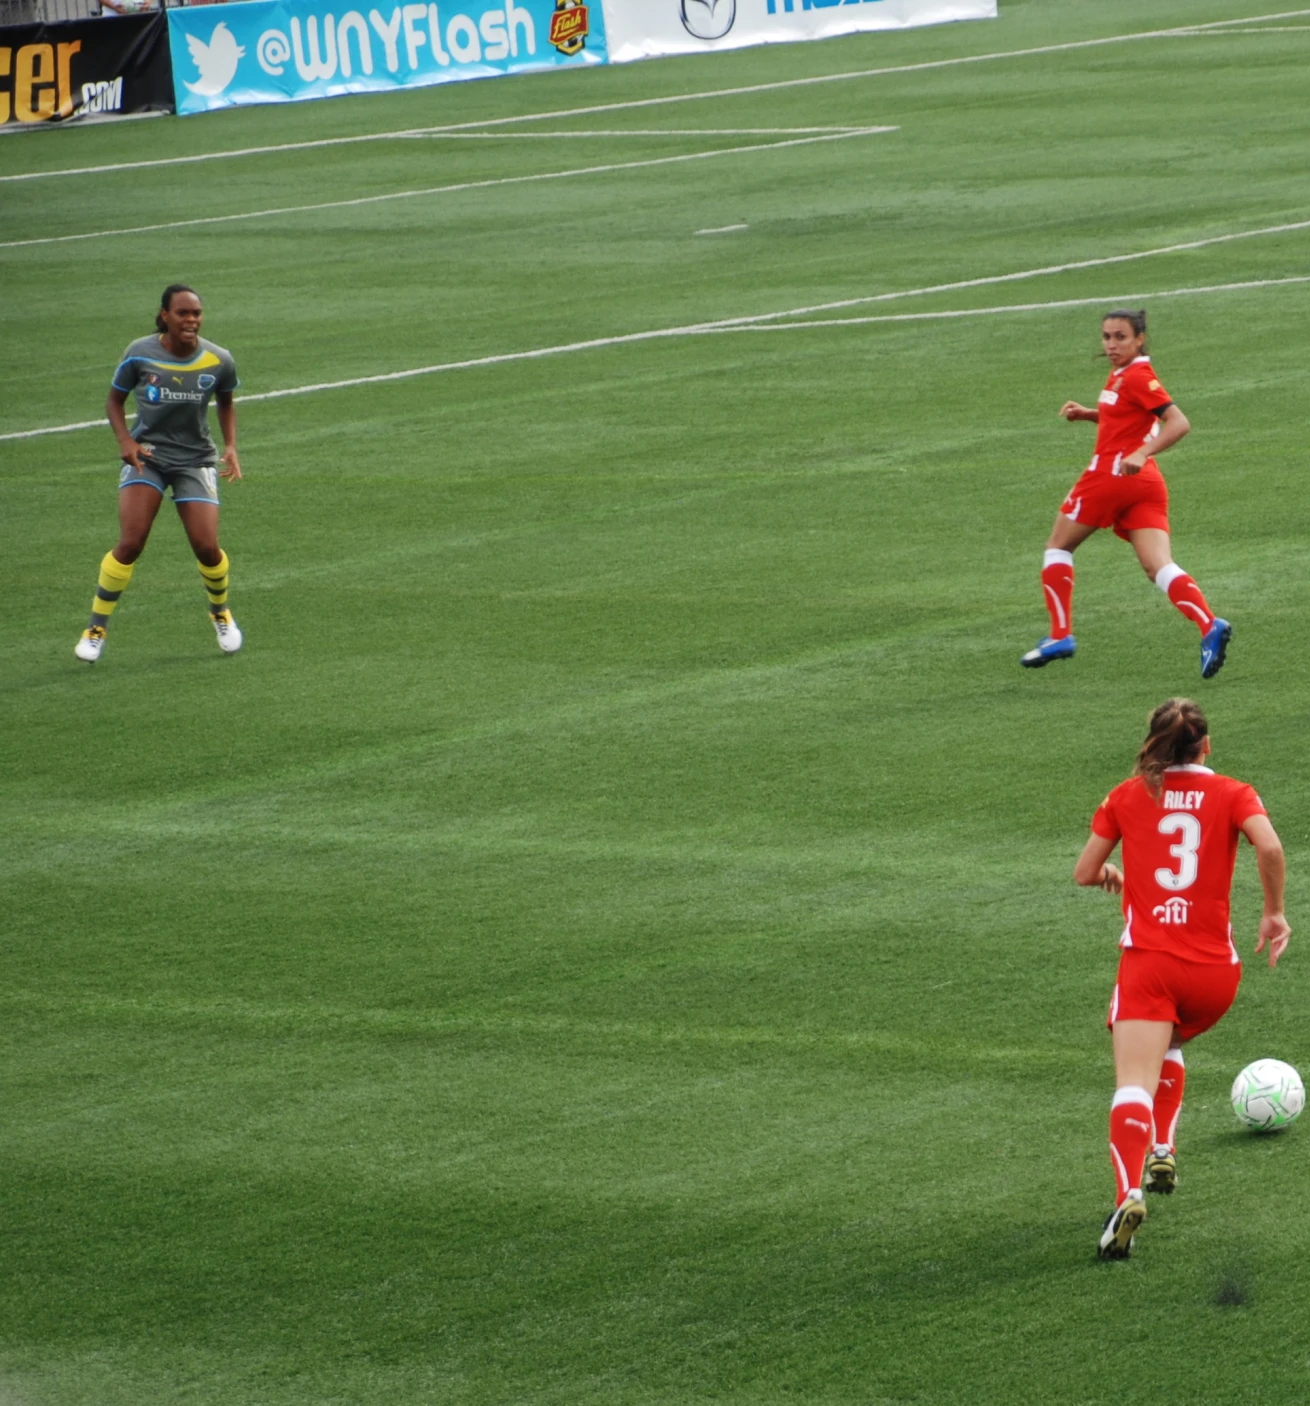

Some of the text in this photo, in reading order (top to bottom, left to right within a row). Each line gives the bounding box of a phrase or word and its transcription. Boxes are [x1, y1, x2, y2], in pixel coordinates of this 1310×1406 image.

[257, 0, 536, 82] @WNYFlash
[160, 387, 204, 401] Premier
[1163, 790, 1205, 810] RILEY
[1154, 811, 1202, 891] 3
[1152, 896, 1189, 925] citi
